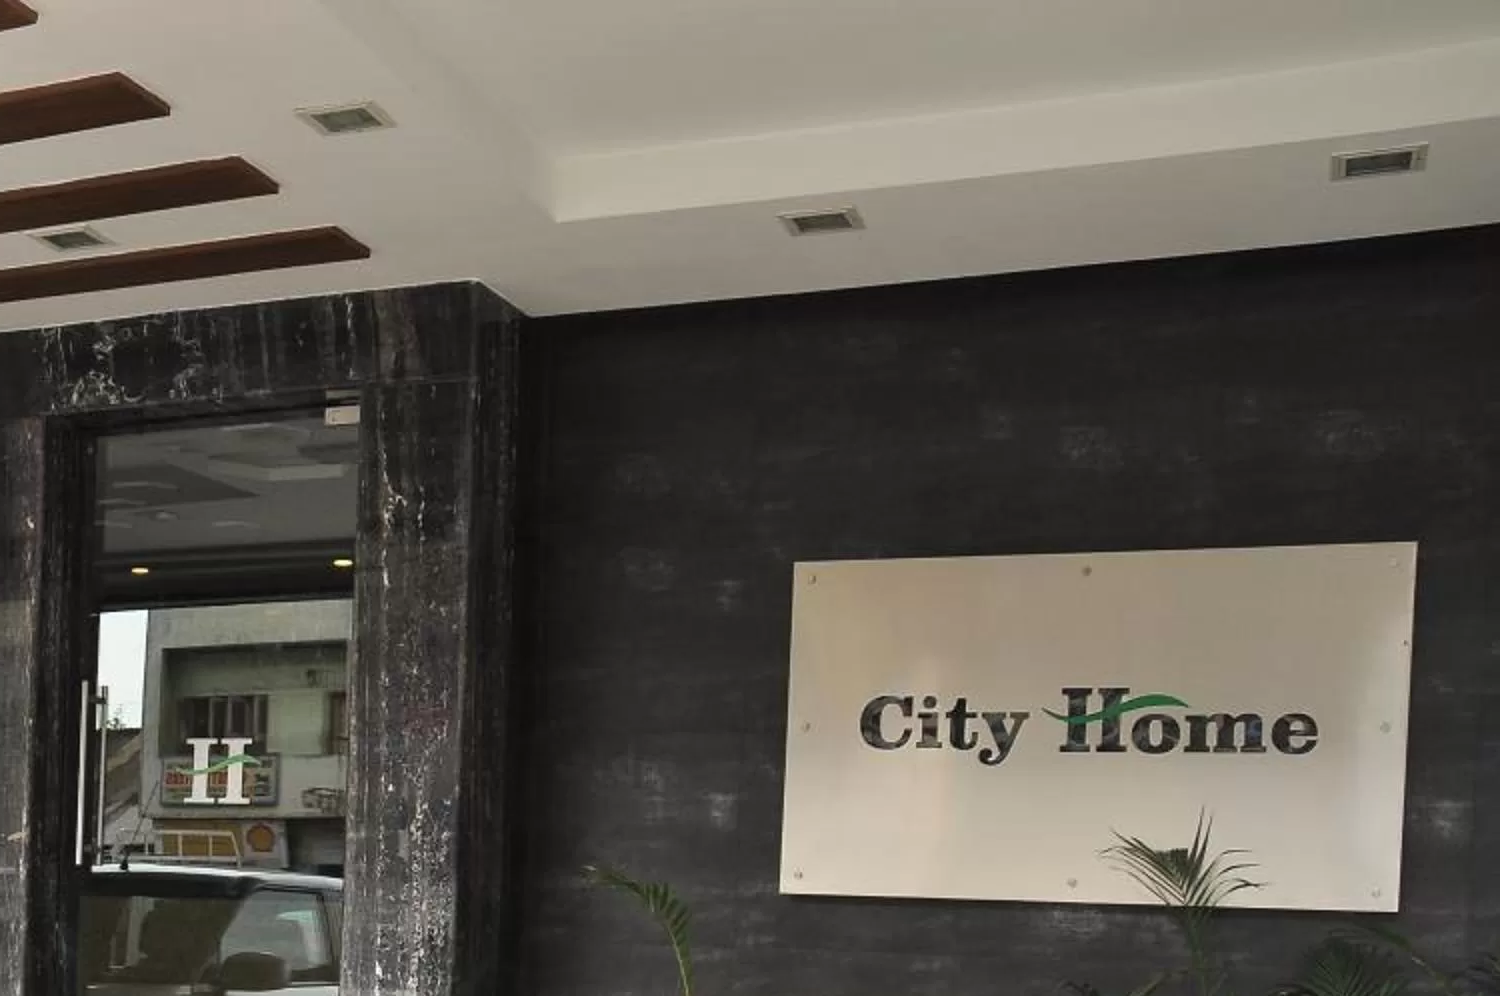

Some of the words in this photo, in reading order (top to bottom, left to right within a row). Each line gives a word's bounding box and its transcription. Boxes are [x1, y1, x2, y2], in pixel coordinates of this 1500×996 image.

[859, 694, 1031, 766] City
[1057, 686, 1320, 755] Home
[182, 737, 254, 805] H
